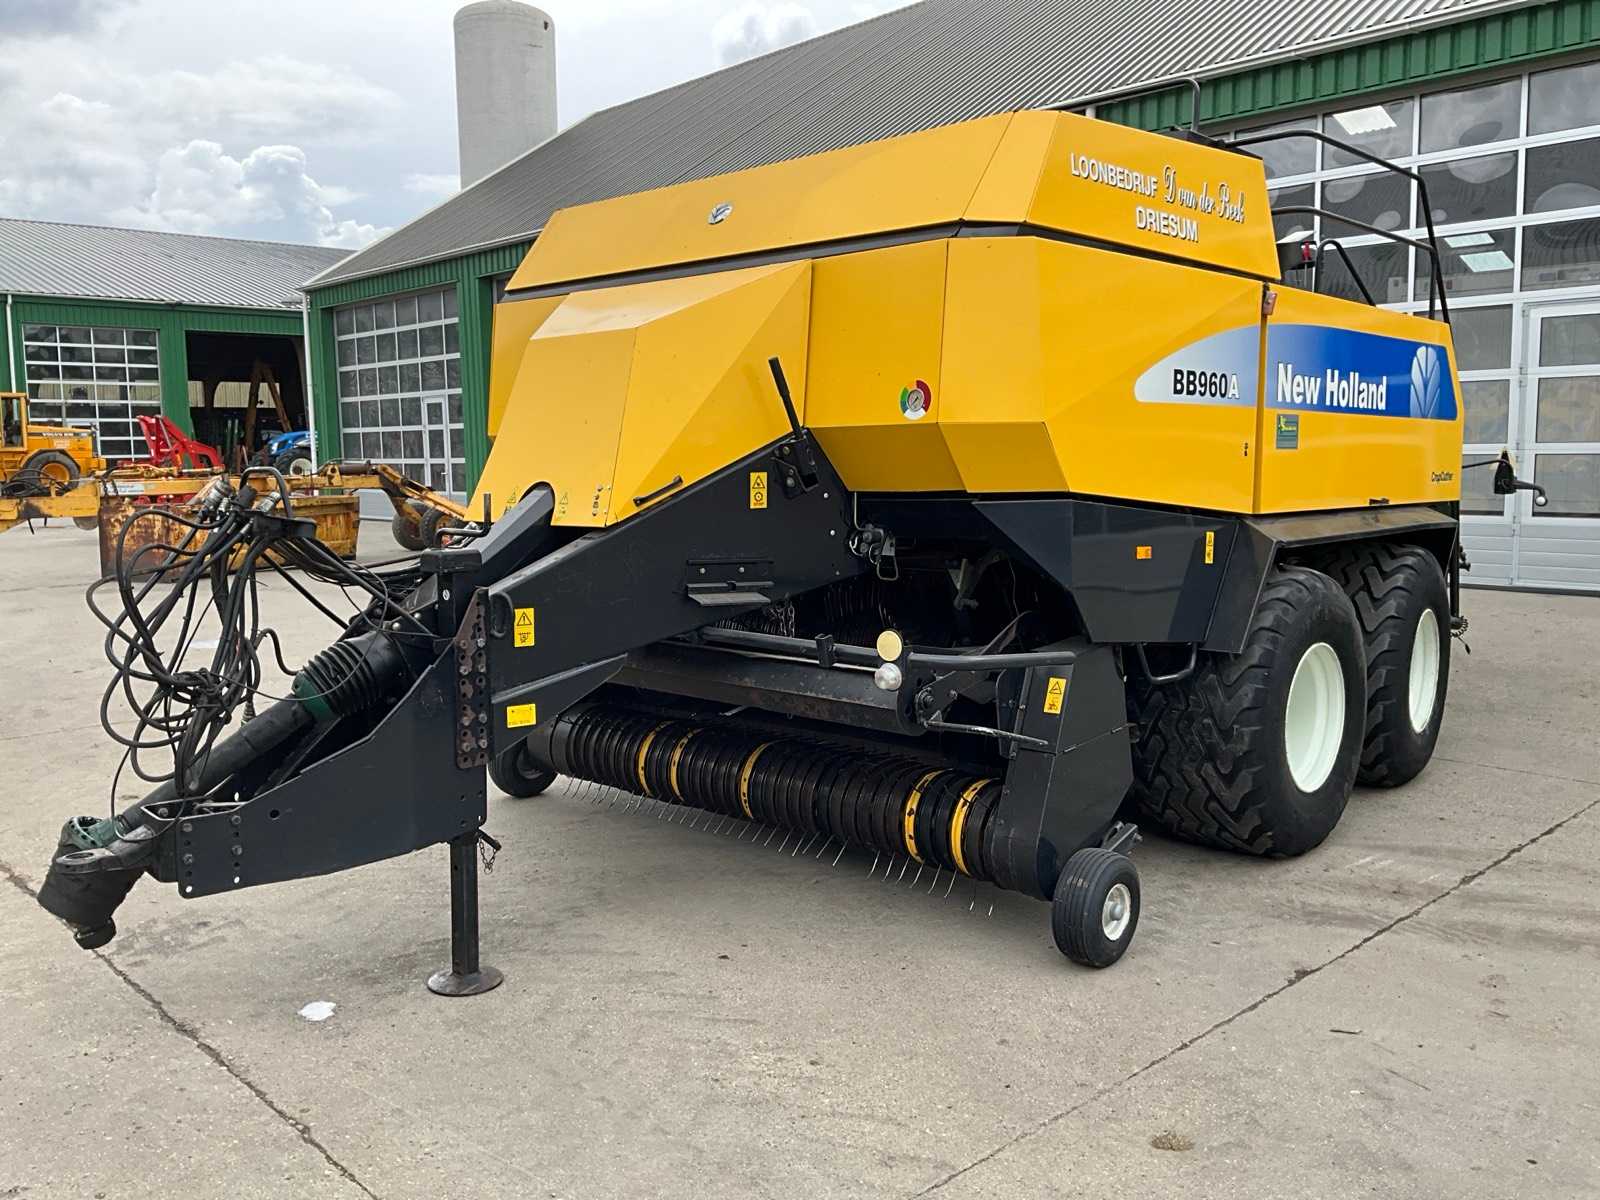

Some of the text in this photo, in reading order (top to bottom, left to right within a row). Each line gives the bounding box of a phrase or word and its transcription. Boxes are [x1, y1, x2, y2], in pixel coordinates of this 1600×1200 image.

[1070, 152, 1158, 198] LOONBEDRIJF
[1135, 206, 1199, 242] DRIESUM
[1173, 369, 1240, 400] BB960A
[1277, 362, 1387, 411] New Holland
